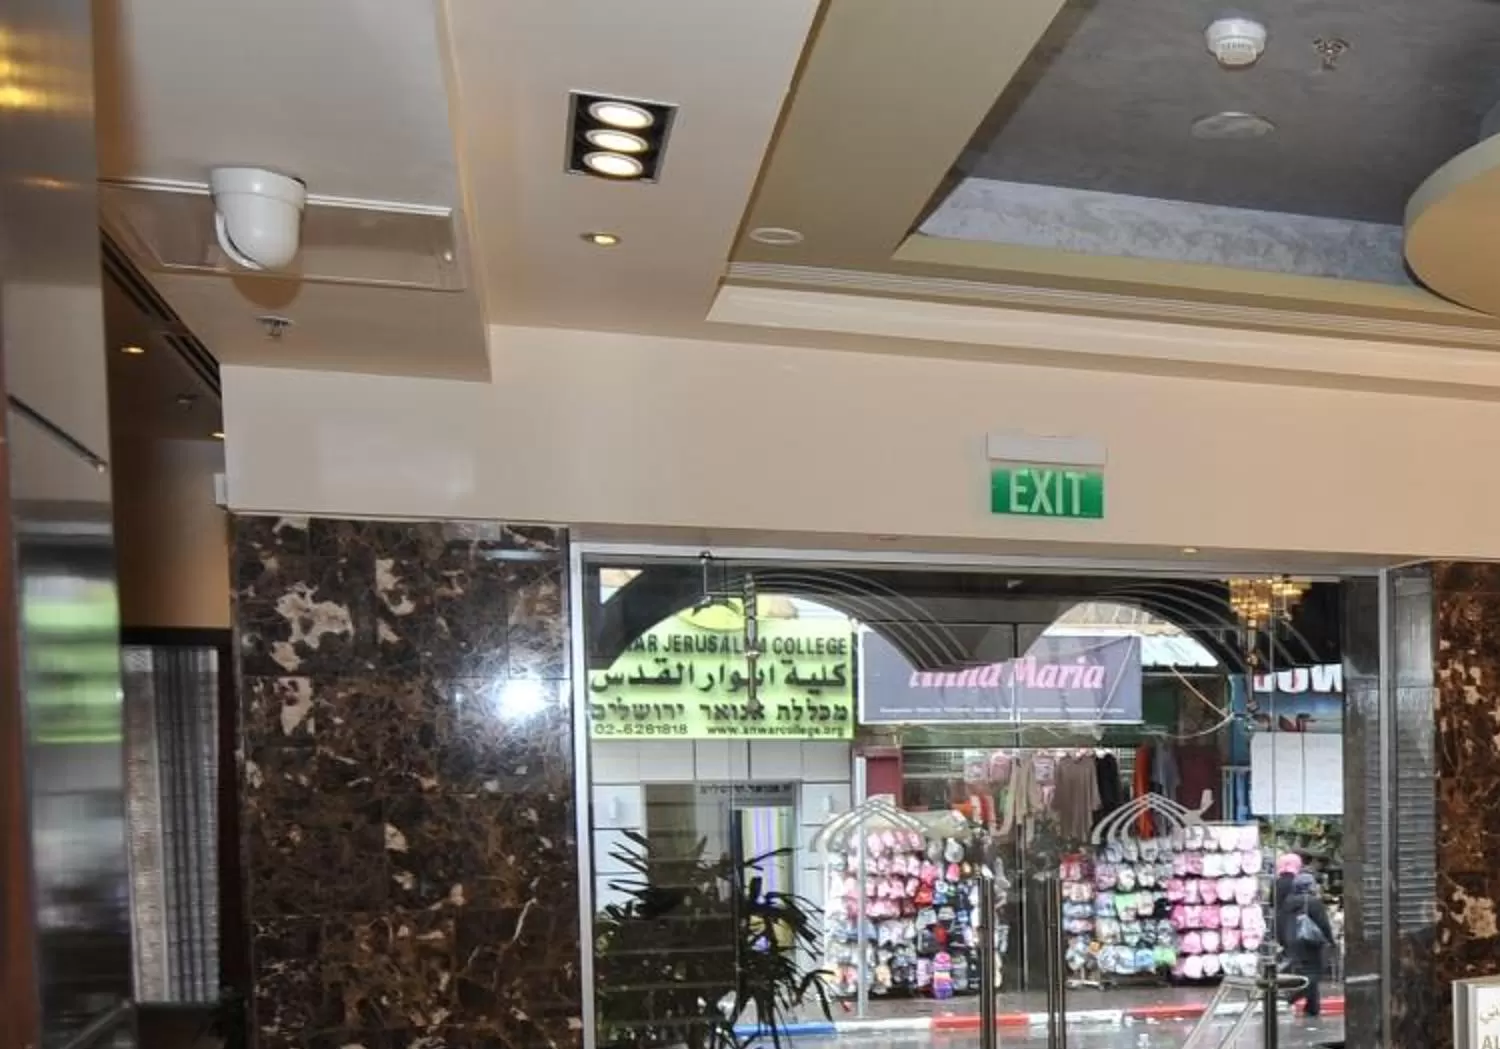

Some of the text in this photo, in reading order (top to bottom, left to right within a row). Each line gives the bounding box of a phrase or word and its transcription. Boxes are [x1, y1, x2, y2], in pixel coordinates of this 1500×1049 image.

[1009, 468, 1087, 515] EXIT
[664, 634, 767, 653] JERUSALM
[772, 636, 848, 655] COLLEGE
[590, 656, 694, 693] القدس
[783, 658, 846, 695] كلية
[1005, 655, 1105, 689] Maria
[590, 697, 685, 721] ירושלים
[777, 697, 848, 721] מכללת
